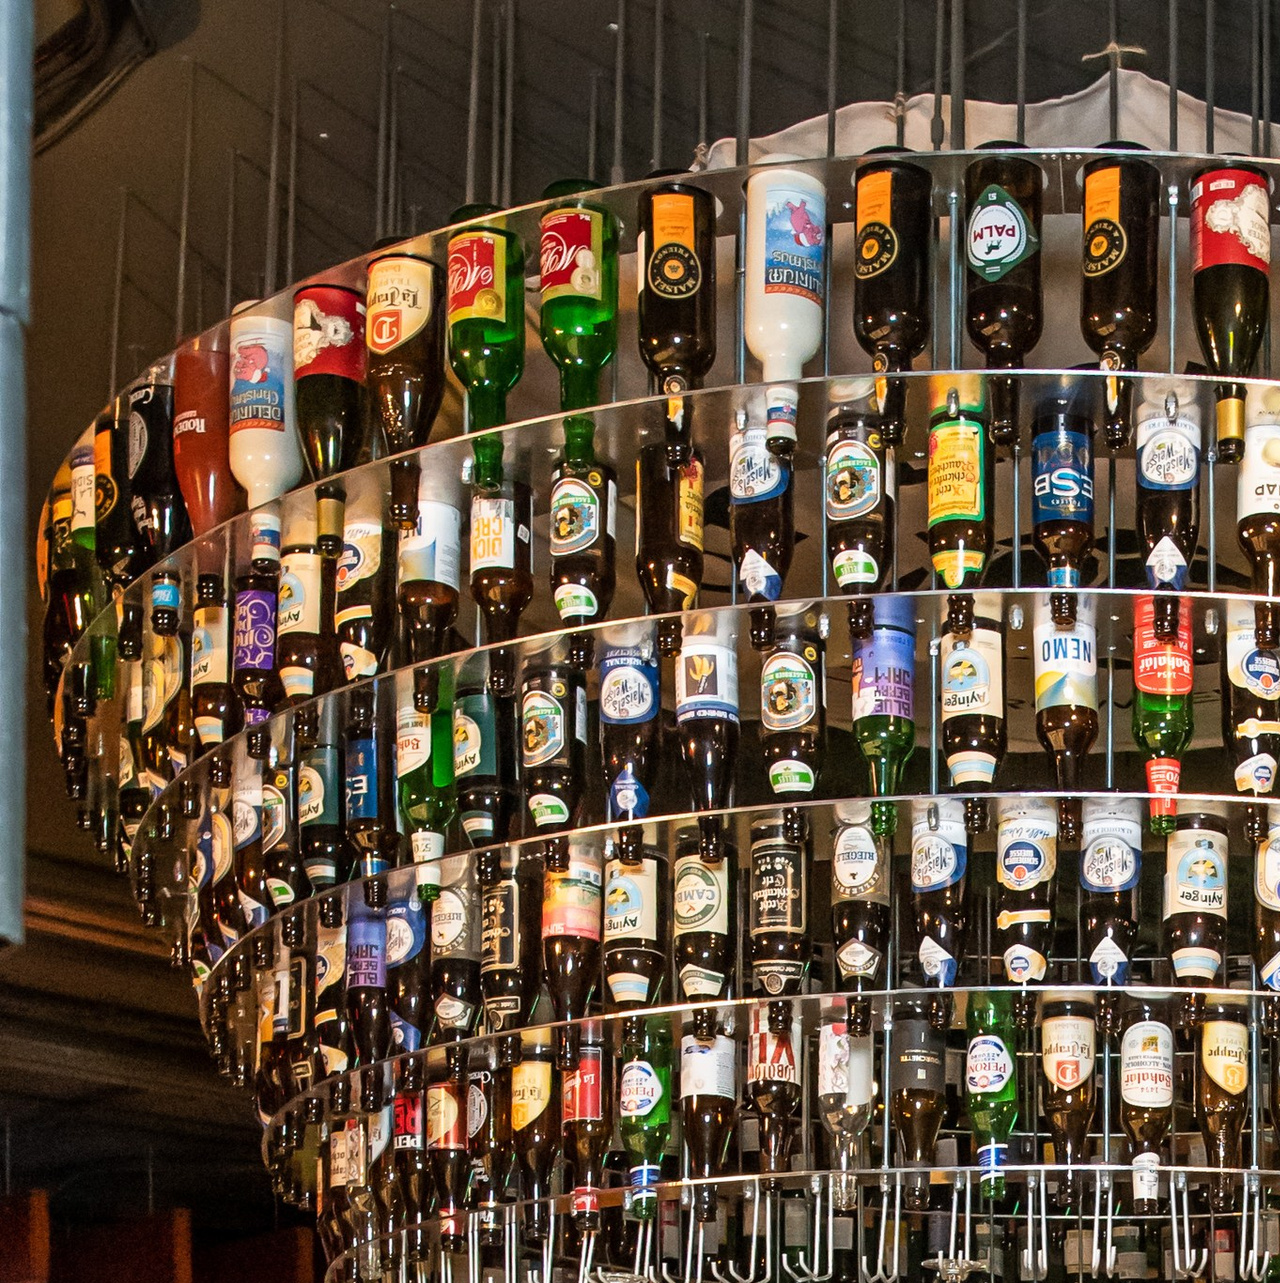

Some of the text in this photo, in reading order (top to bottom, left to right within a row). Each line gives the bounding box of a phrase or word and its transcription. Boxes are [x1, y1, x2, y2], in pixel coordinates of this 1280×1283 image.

[974, 223, 1016, 243] PALM
[1034, 467, 1094, 498] ESB
[1042, 638, 1092, 663] NEMO
[1139, 655, 1191, 674] Bakalář
[874, 667, 911, 684] JAM
[873, 685, 911, 700] BERRY
[944, 691, 987, 707] Ayinger
[873, 701, 911, 715] BLUE
[1179, 890, 1224, 907] Ayinger
[1043, 1043, 1092, 1060] La Trappe
[1124, 1072, 1173, 1087] Bakalář
